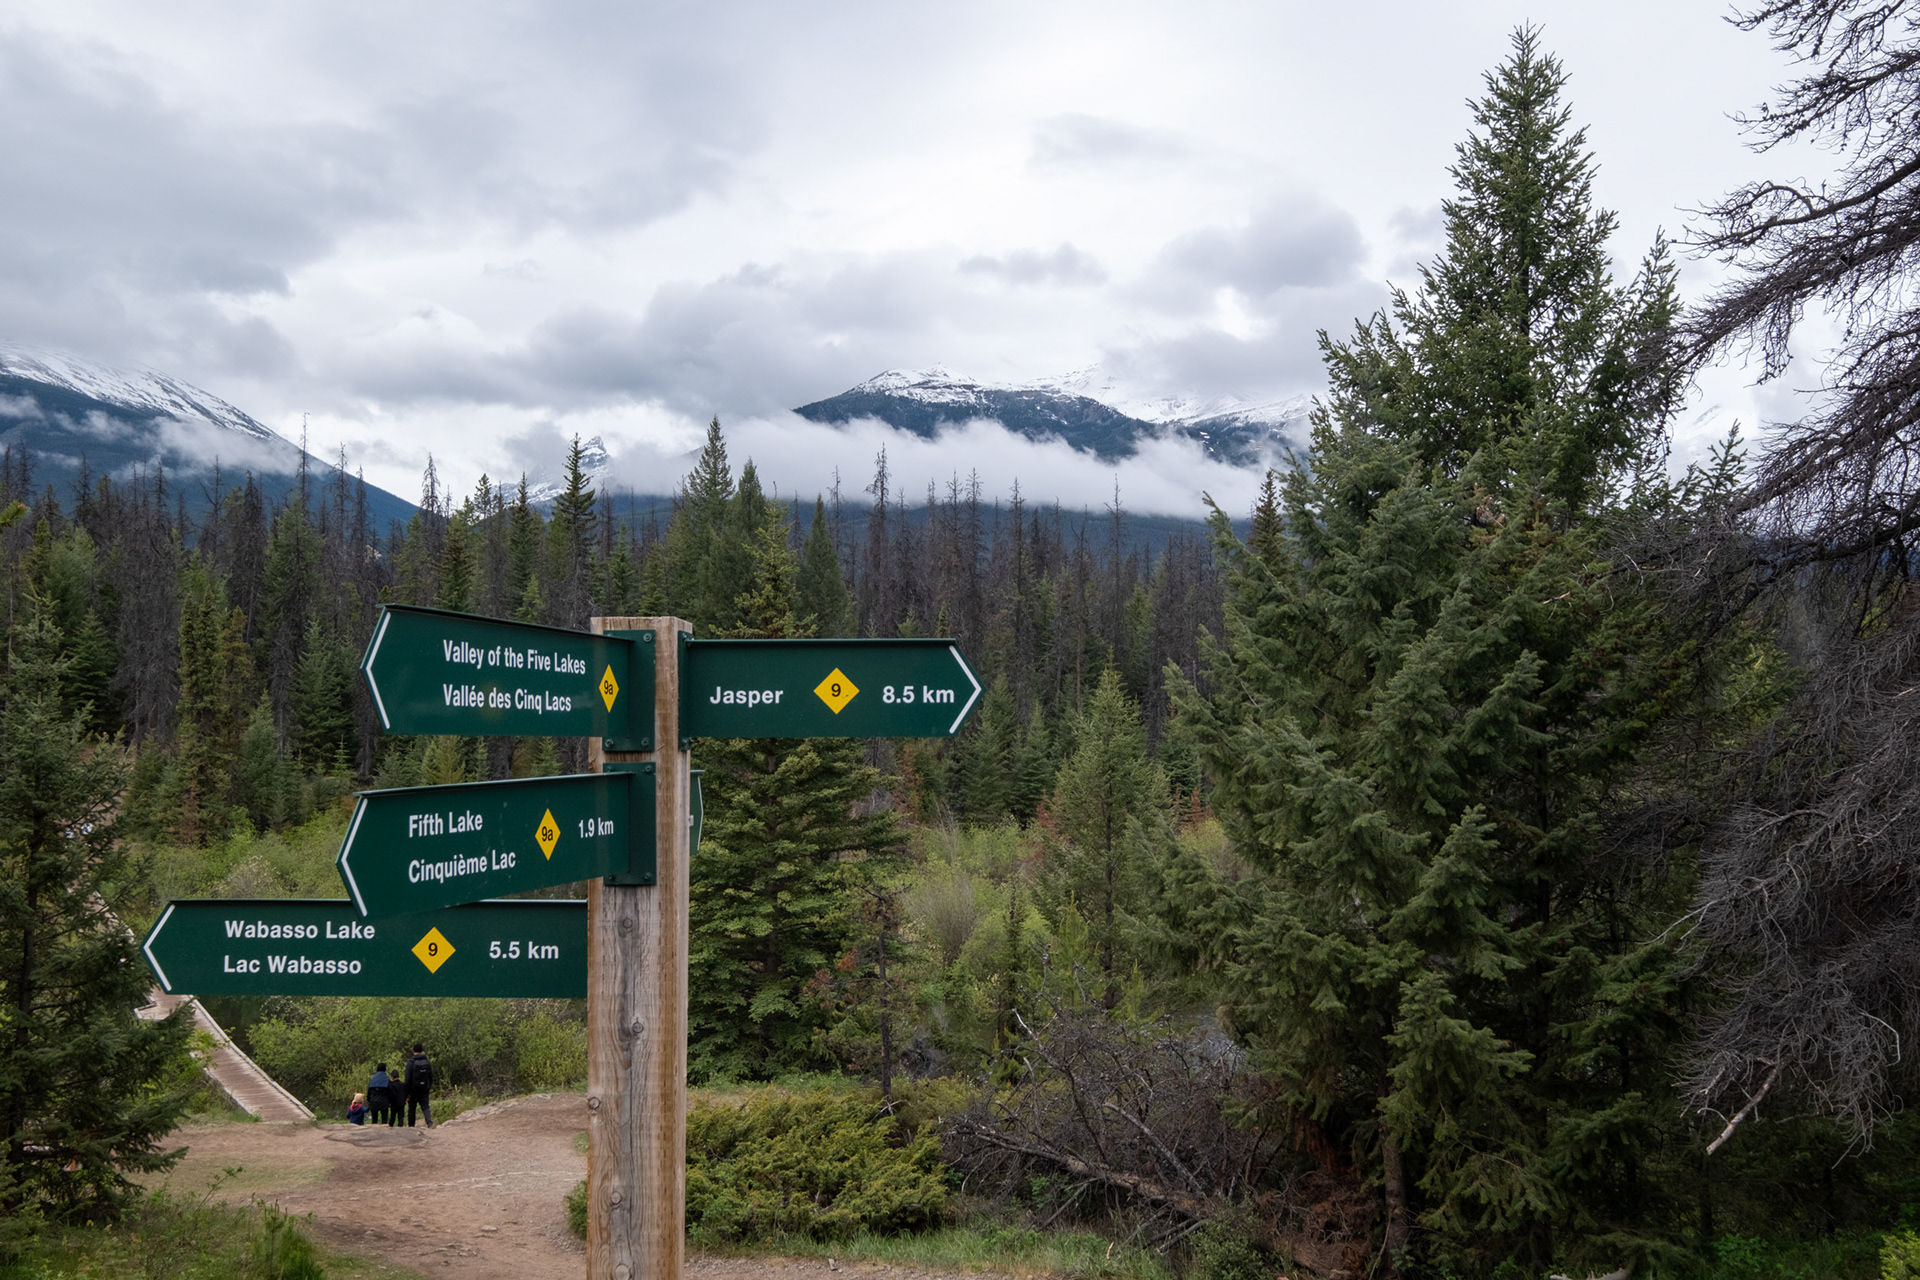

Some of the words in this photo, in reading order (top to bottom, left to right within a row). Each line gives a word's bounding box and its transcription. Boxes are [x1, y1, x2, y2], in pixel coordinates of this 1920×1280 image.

[443, 640, 484, 669] Valley
[488, 646, 501, 666] of
[504, 647, 523, 668] the
[528, 649, 550, 671] Five
[555, 653, 585, 674] Lakes
[604, 680, 614, 695] 9a
[710, 686, 783, 707] Jasper
[831, 684, 841, 698] 9
[883, 686, 915, 703] 8.5
[923, 686, 955, 703] km
[443, 684, 484, 707] Vallée
[489, 687, 511, 708] des
[515, 689, 541, 714] Cinq
[546, 691, 571, 711] Lacs
[409, 813, 443, 837] Fifth
[449, 810, 482, 833] Lake
[579, 819, 595, 838] 1.9
[598, 818, 614, 835] km
[541, 826, 554, 842] 9a
[409, 854, 487, 883] Cinquième
[492, 850, 515, 870] Lac
[225, 921, 318, 938] Wabasso
[326, 921, 375, 939] Lake
[428, 943, 438, 957] 9
[490, 941, 521, 959] 5.5
[529, 941, 559, 959] km
[224, 955, 260, 973] Lac
[268, 956, 361, 974] Wabasso
